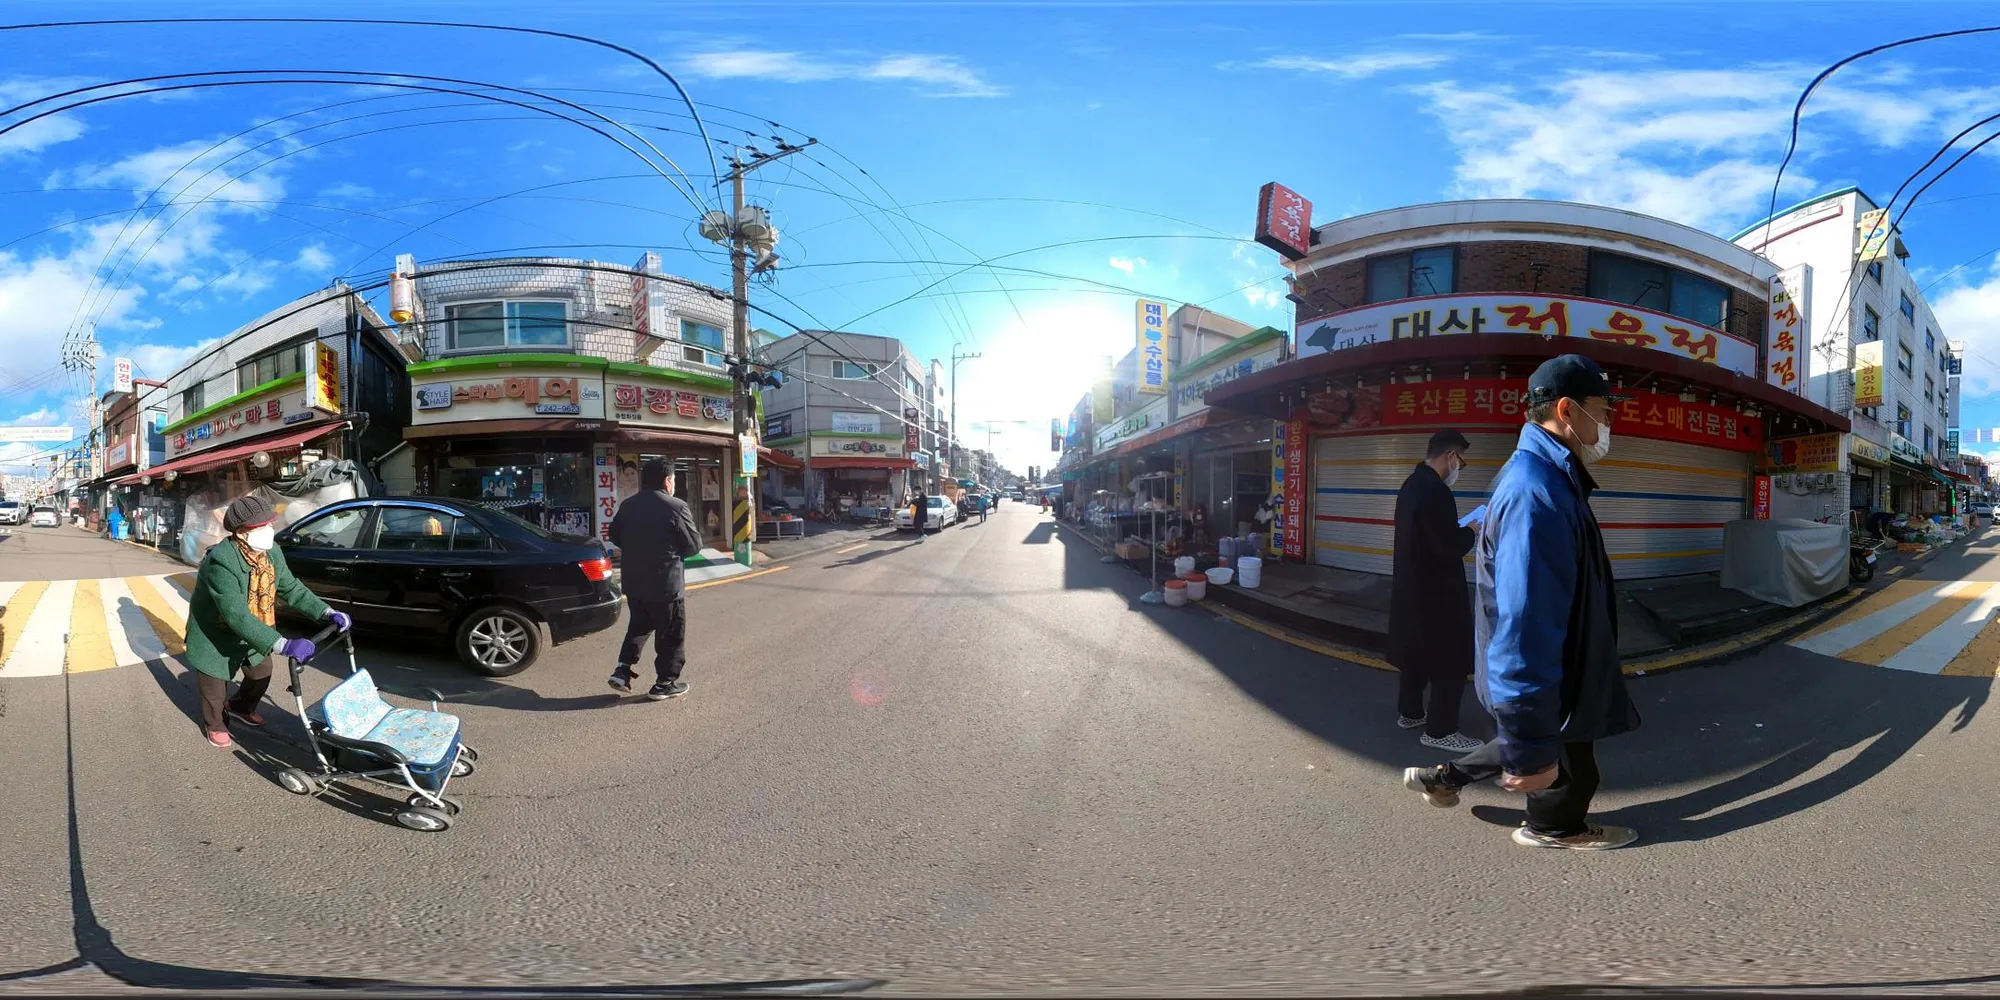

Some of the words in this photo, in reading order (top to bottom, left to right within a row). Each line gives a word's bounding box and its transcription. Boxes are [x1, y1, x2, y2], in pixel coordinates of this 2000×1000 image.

[1771, 303, 1796, 385] 정육점
[119, 362, 130, 384] 안경
[426, 390, 449, 398] STYLE
[615, 384, 700, 418] 화장품
[1285, 543, 1301, 556] 전문
